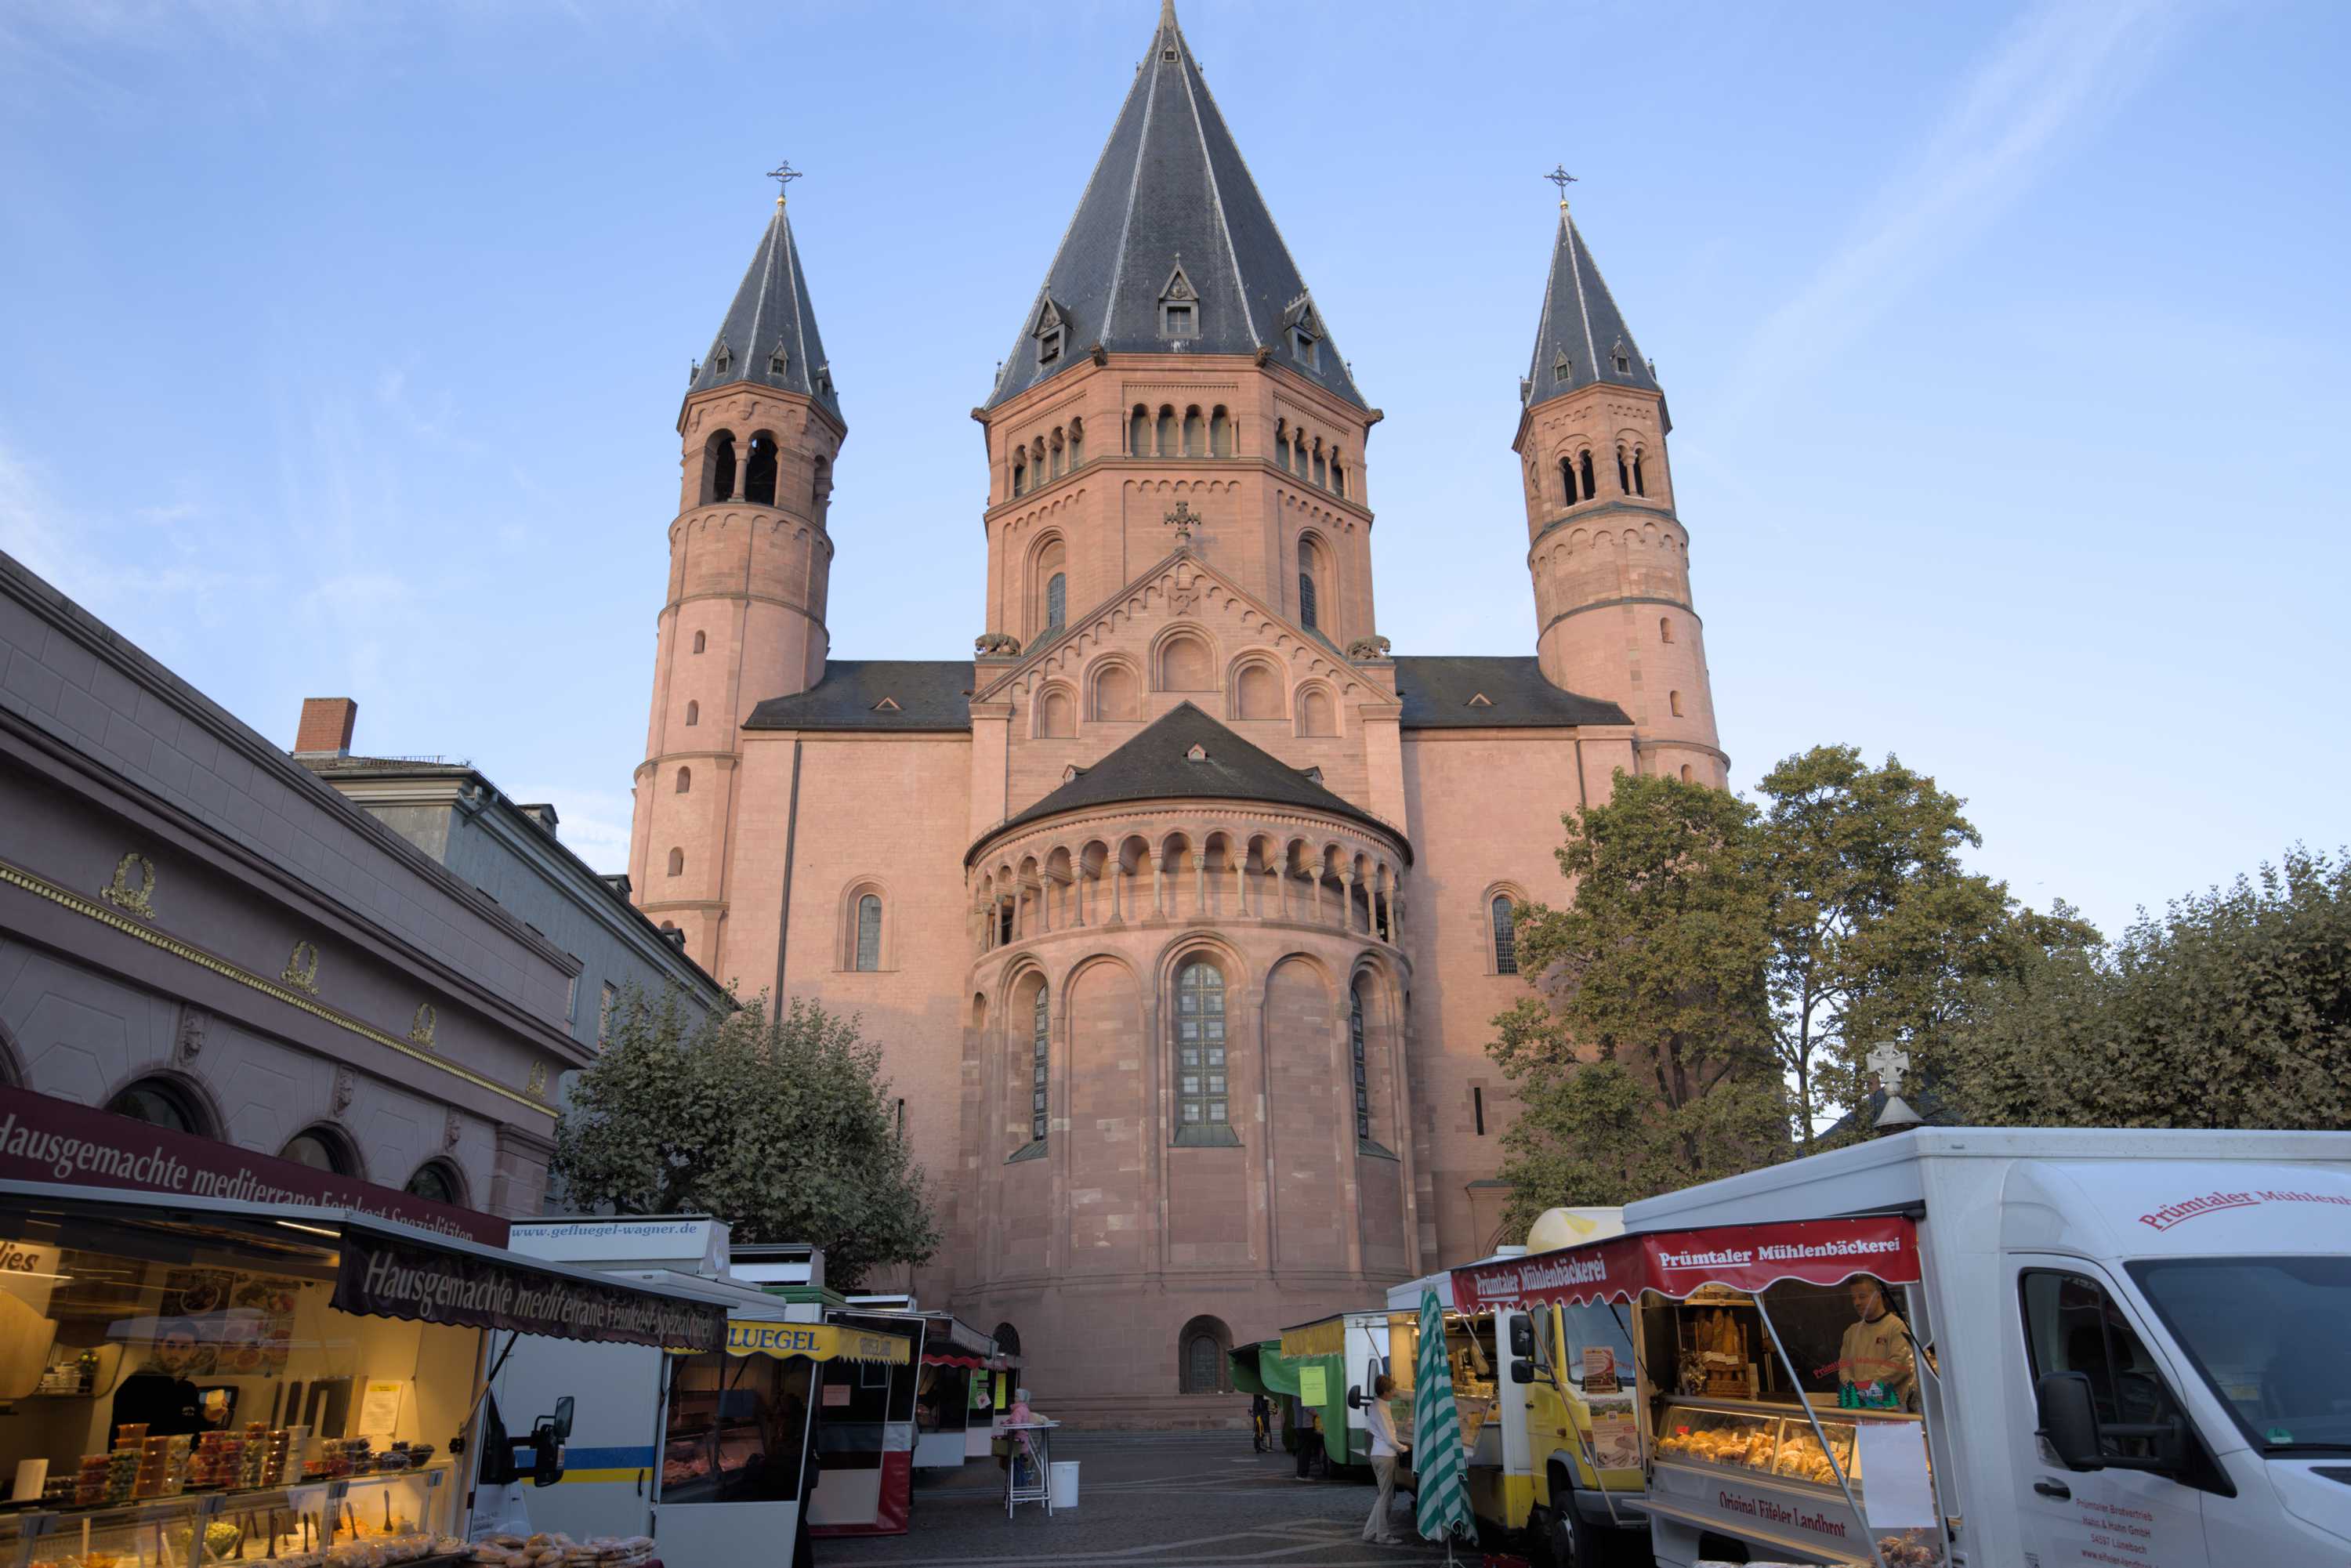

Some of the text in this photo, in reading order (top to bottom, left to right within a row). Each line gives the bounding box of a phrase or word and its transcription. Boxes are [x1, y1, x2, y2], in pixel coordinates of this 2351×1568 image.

[2139, 1191, 2254, 1230] Prümtaler
[512, 1223, 697, 1238] www.gefluegel-wagner.de
[1659, 1237, 1900, 1267] Prümtaler Mühlenbäckerei
[363, 1251, 513, 1317] Hausgemachte
[513, 1283, 605, 1327] mediterrane
[1474, 1251, 1607, 1296] Prümtaler Mühlenbäckerei
[1719, 1491, 1846, 1537] Original Eifeler Landbrot
[2128, 1525, 2150, 1538] GmbH
